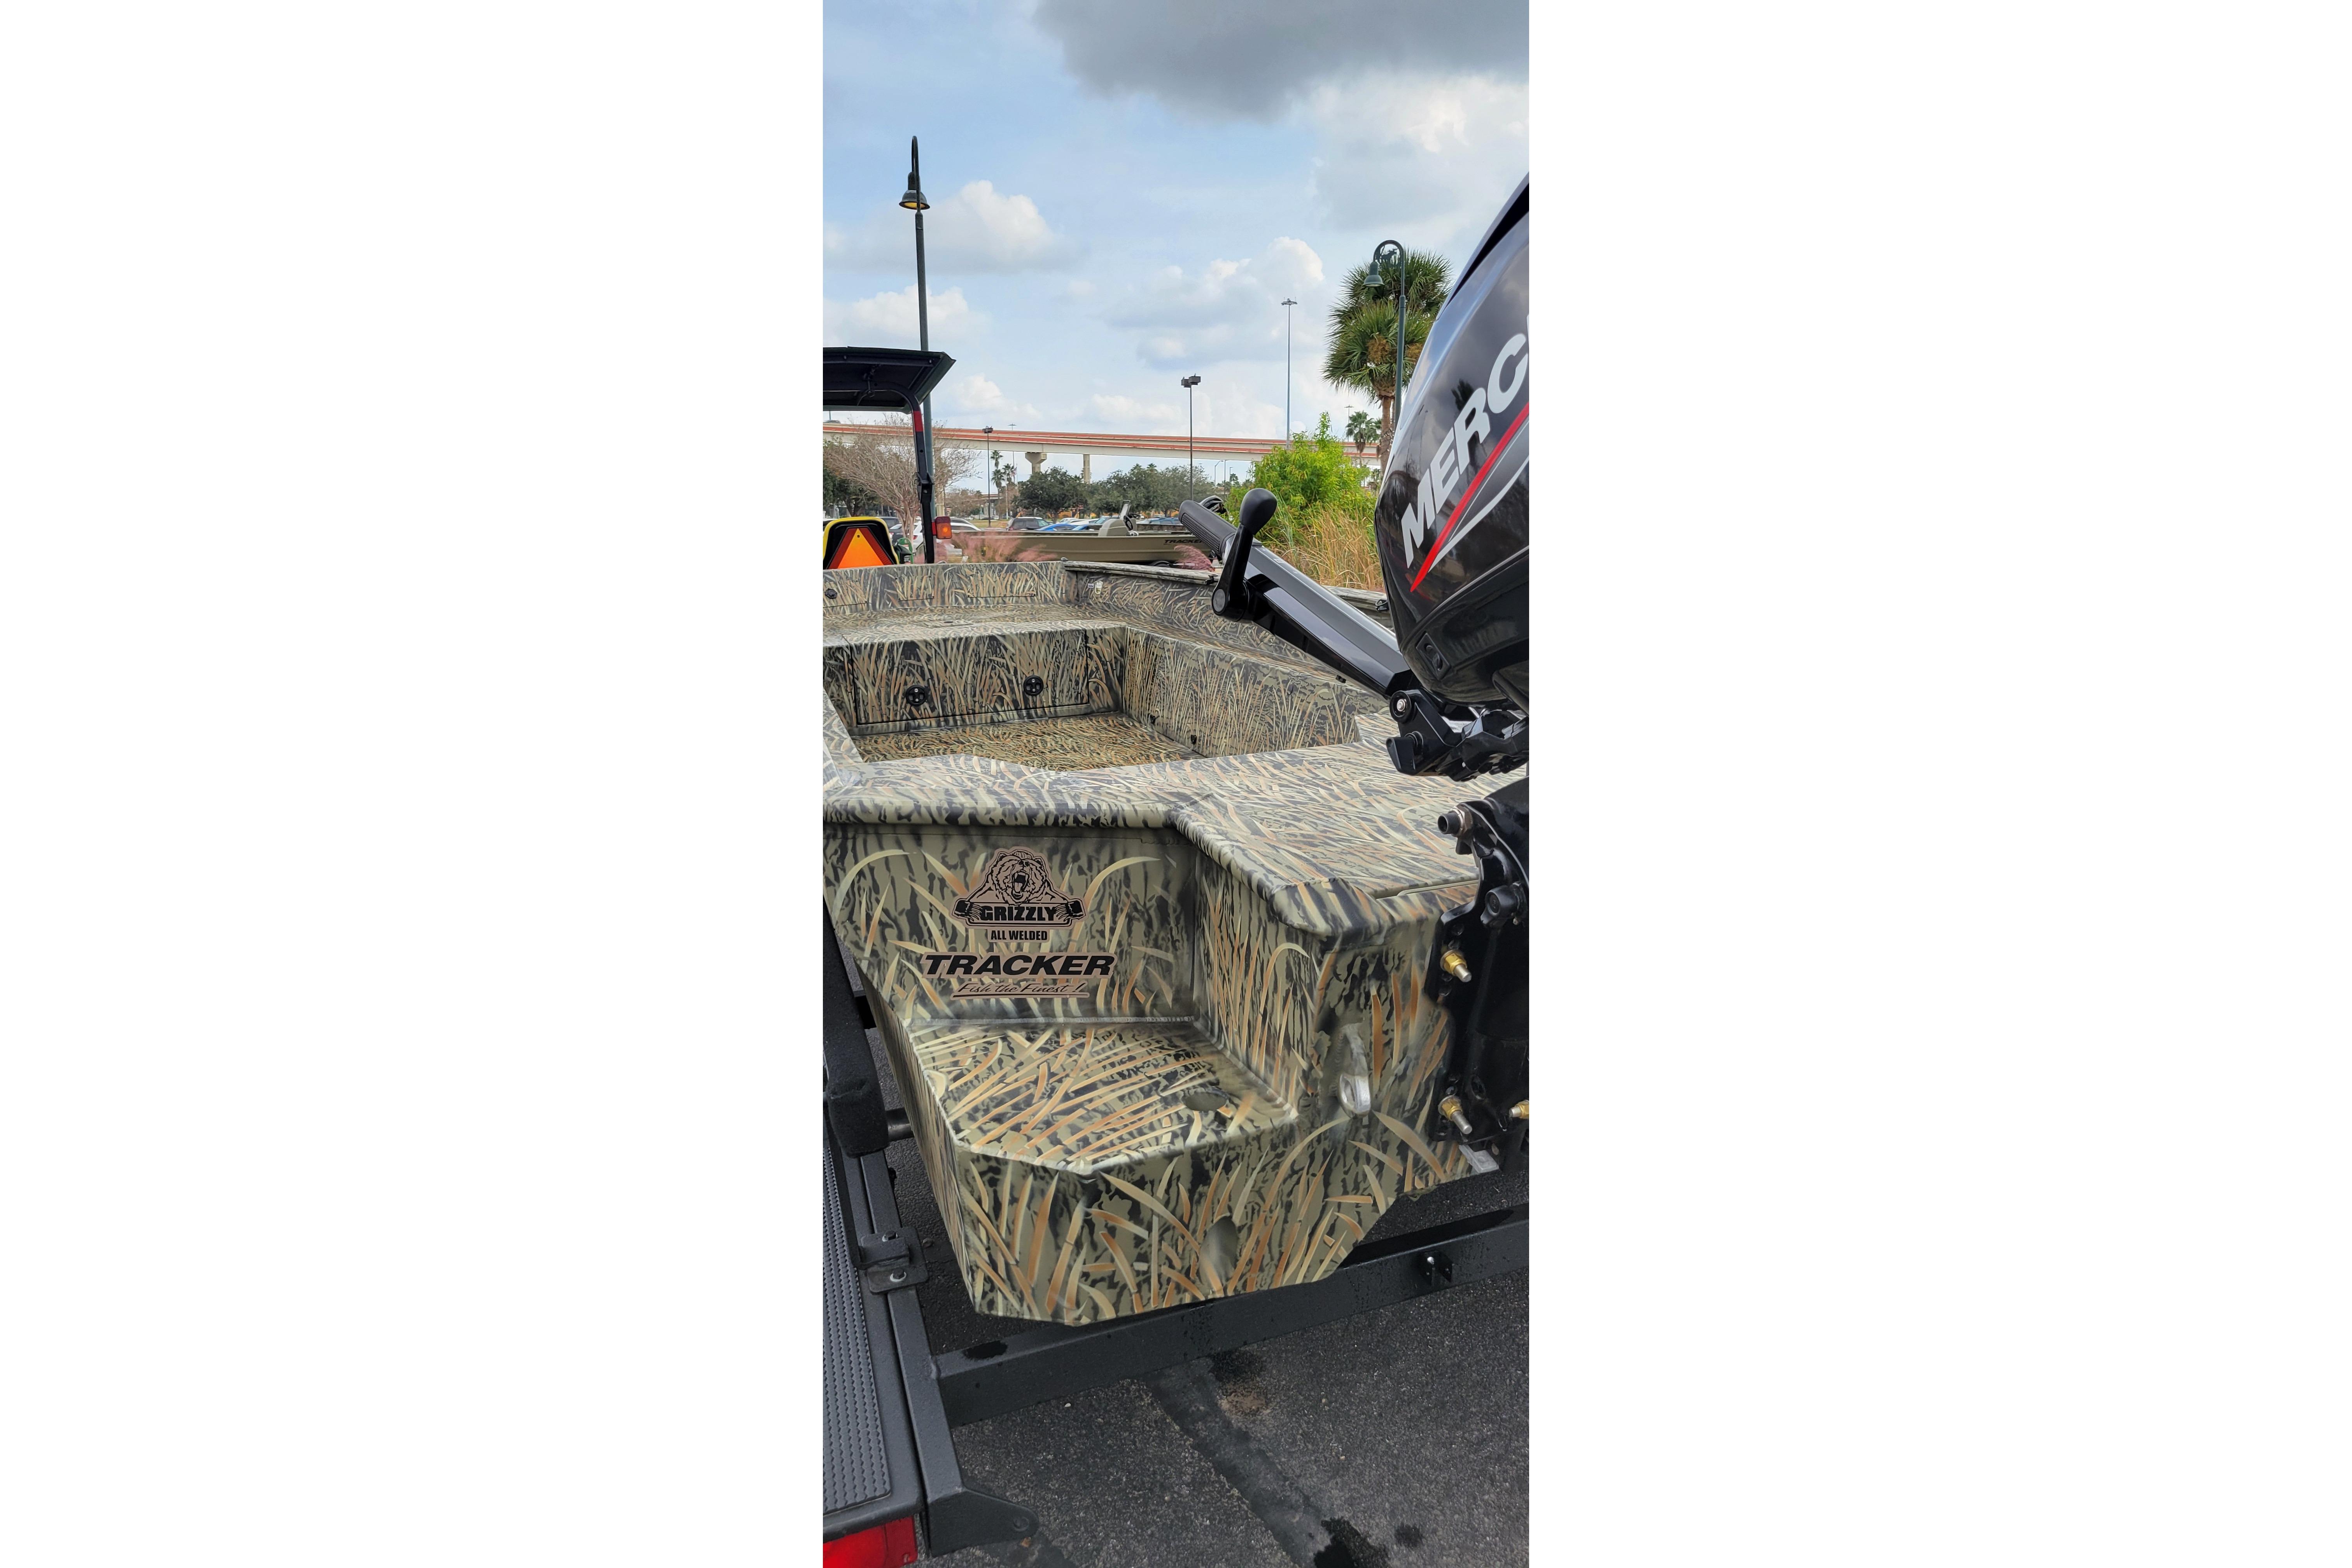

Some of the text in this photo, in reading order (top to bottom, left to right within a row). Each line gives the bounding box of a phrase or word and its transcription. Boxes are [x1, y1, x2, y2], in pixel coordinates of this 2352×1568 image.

[1401, 314, 1529, 569] MERC
[980, 905, 1056, 921] GRIZZLY
[991, 930, 1047, 940] ALL WELDED
[926, 955, 1115, 975] TRACKER
[957, 983, 991, 992] Fish
[994, 984, 1019, 992] the
